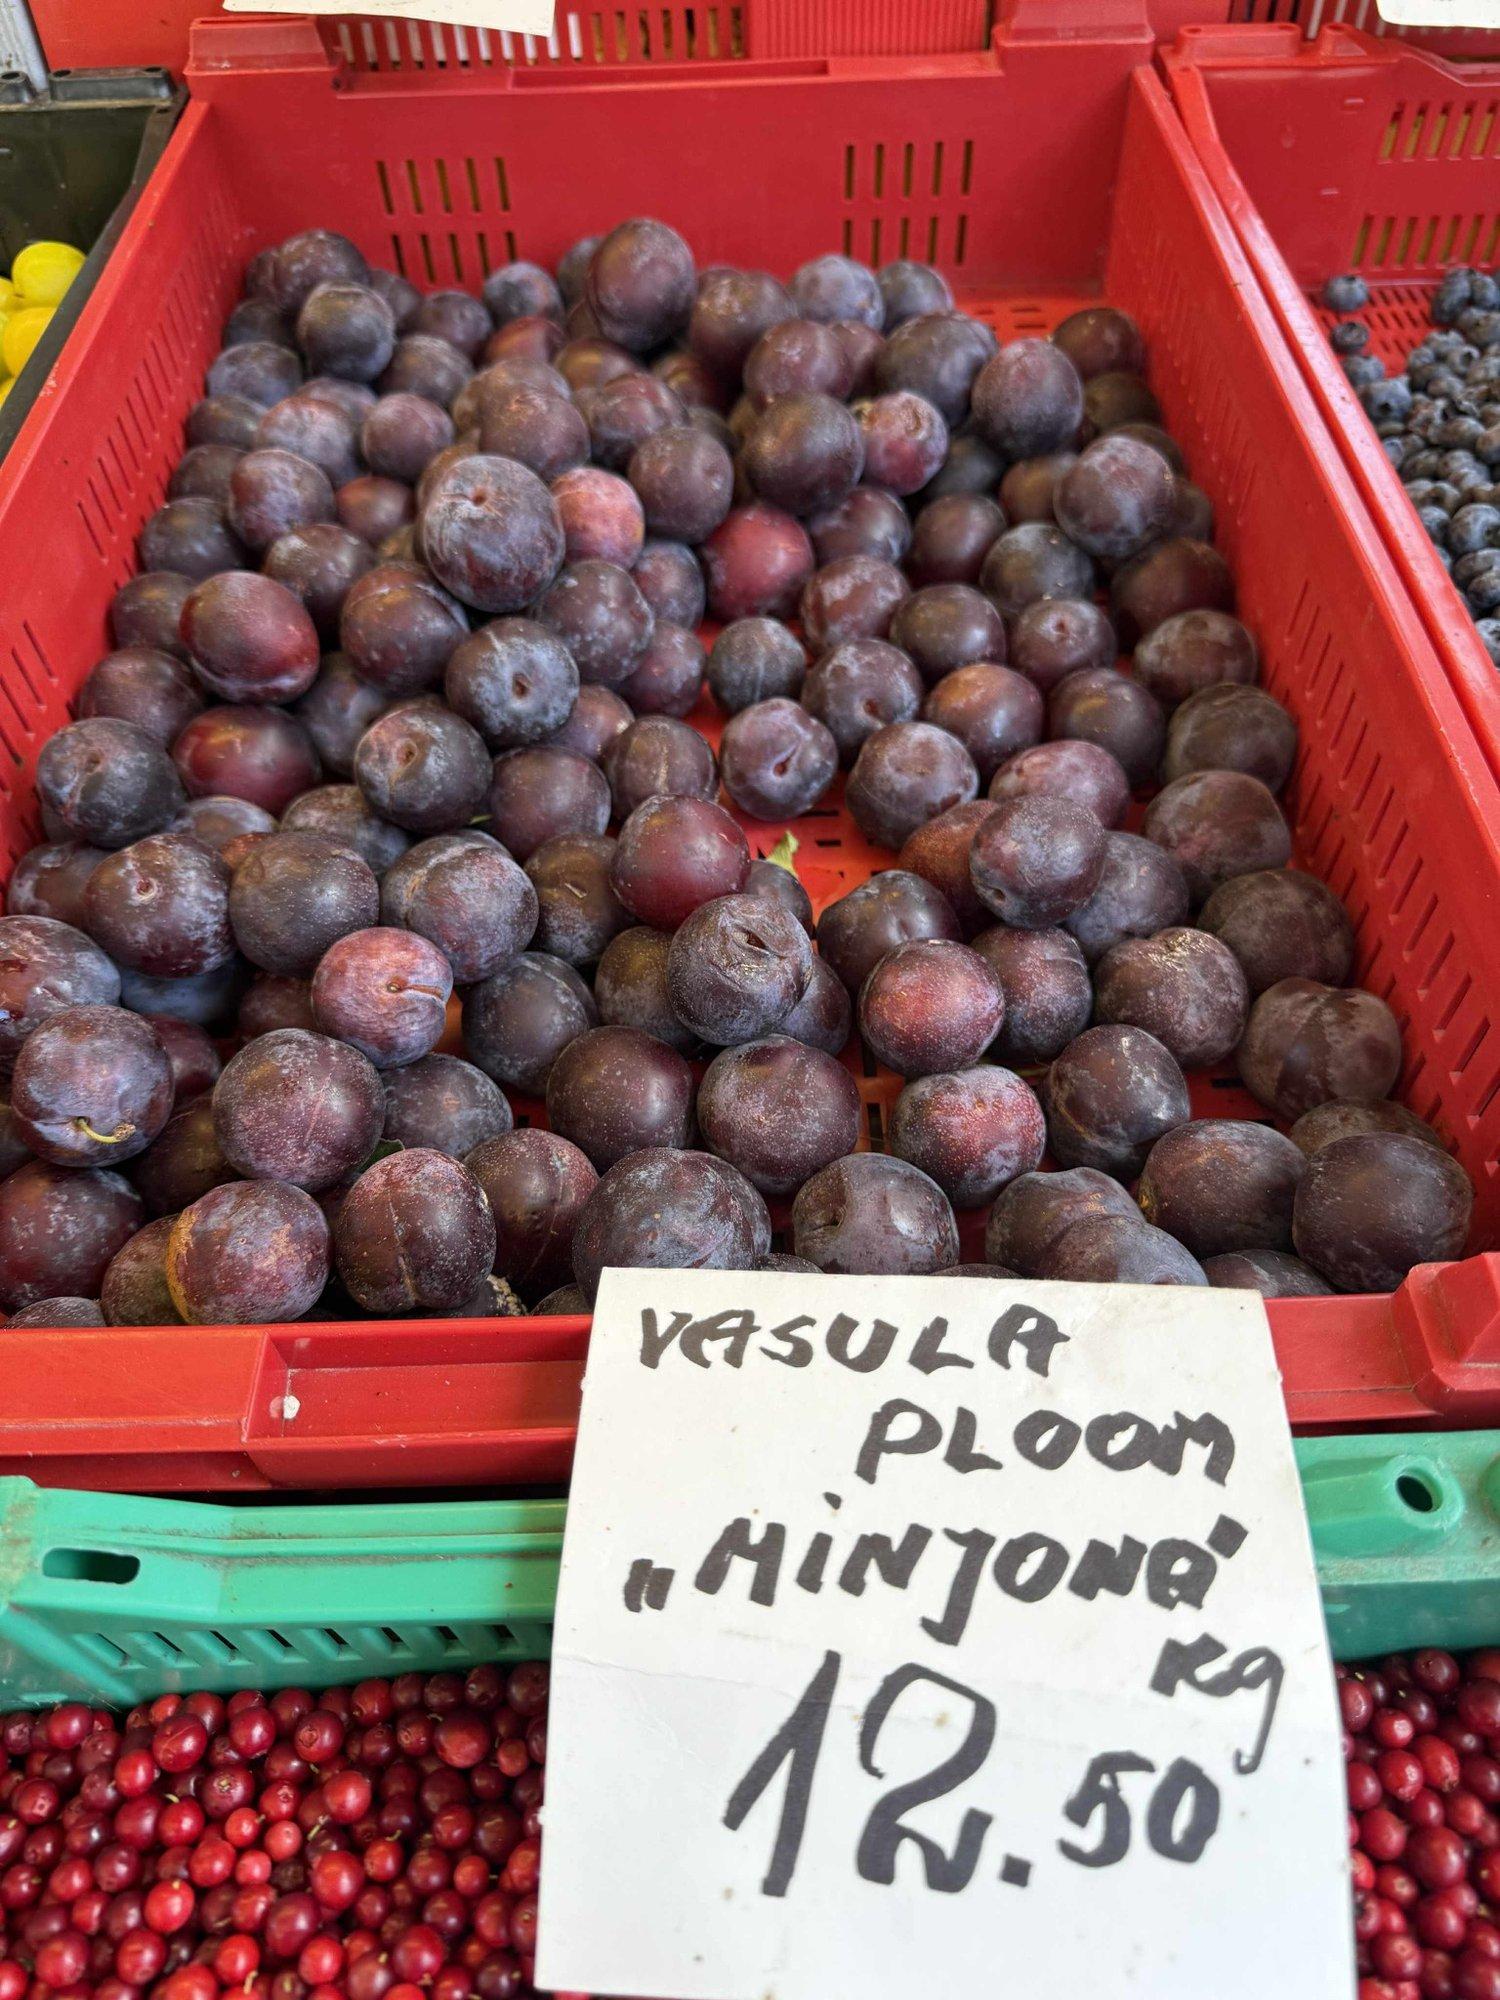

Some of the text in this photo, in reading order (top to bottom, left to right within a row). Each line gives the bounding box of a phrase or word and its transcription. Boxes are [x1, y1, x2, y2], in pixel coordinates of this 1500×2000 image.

[639, 1304, 1072, 1378] VASULA
[855, 1398, 1236, 1486] PLOOM
[722, 1650, 1221, 1897] 12.50
